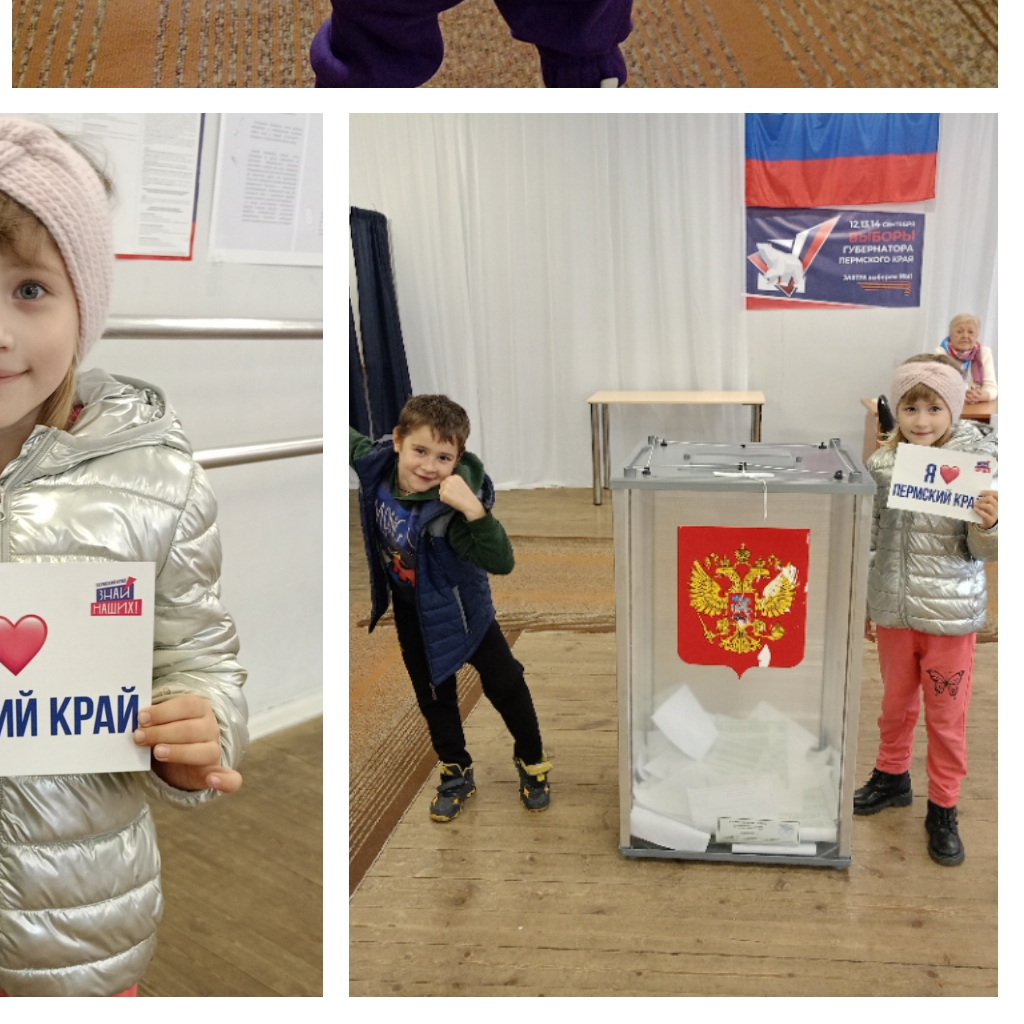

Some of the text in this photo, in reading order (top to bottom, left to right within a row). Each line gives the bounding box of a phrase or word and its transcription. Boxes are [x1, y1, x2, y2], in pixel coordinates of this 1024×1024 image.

[849, 229, 916, 243] ВЫБОРЫ
[842, 244, 914, 254] ГУБЕРНАТОРА
[838, 255, 915, 265] ПЕРМСКОГО КРАЯ
[924, 463, 937, 484] Я
[892, 483, 982, 510] ПЕРМСКИЙ КРА
[93, 601, 138, 615] НАШИХ!
[50, 686, 139, 736] КРАЙ
